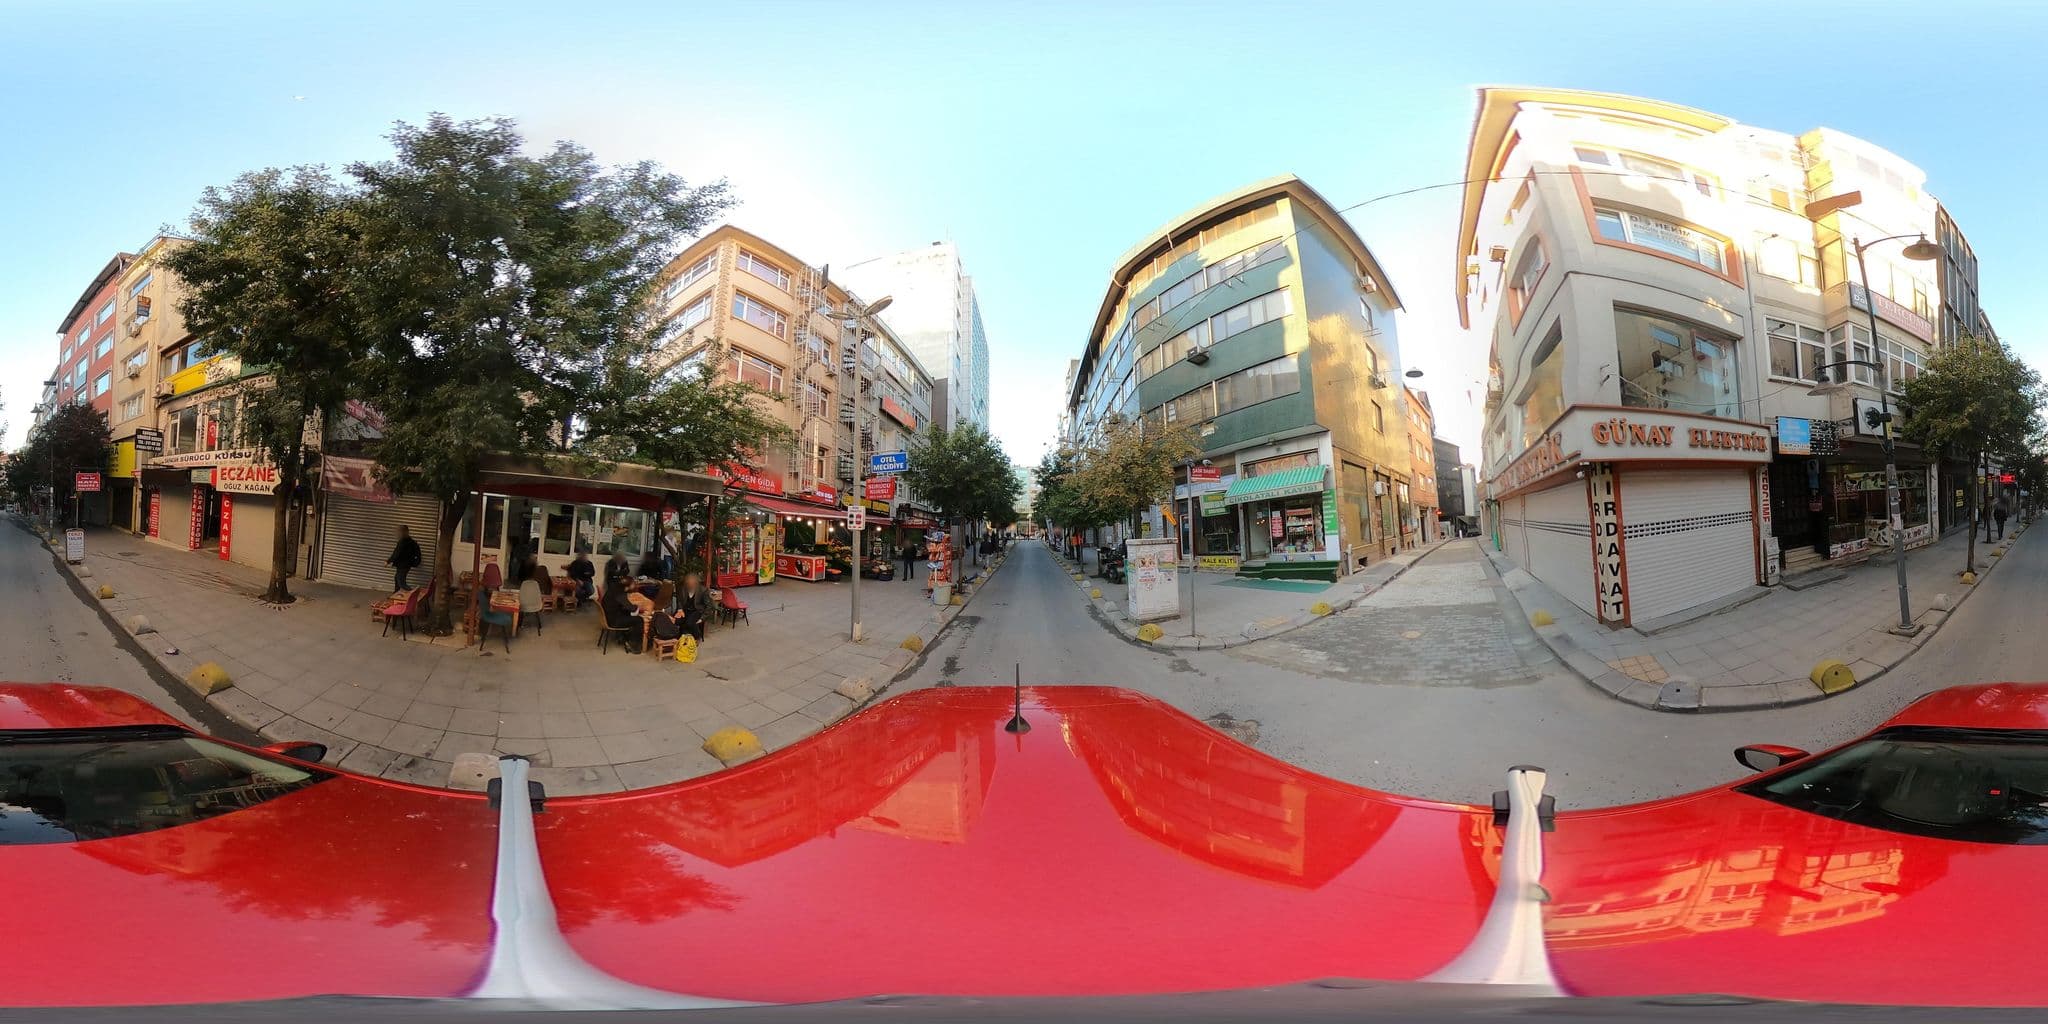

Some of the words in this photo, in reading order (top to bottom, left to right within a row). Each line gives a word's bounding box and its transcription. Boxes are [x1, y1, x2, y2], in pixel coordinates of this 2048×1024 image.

[1591, 418, 1675, 447] GÜNAY
[1688, 427, 1768, 453] ELEKTRİK
[873, 462, 905, 471] MECİDİYE
[880, 456, 897, 464] OTEL
[220, 465, 276, 483] ECZANE
[223, 482, 242, 490] OĞUZ
[244, 484, 271, 492] KAĞAN
[1591, 462, 1608, 614] HIRDAVAT
[1600, 462, 1624, 616] HIRDAVAT
